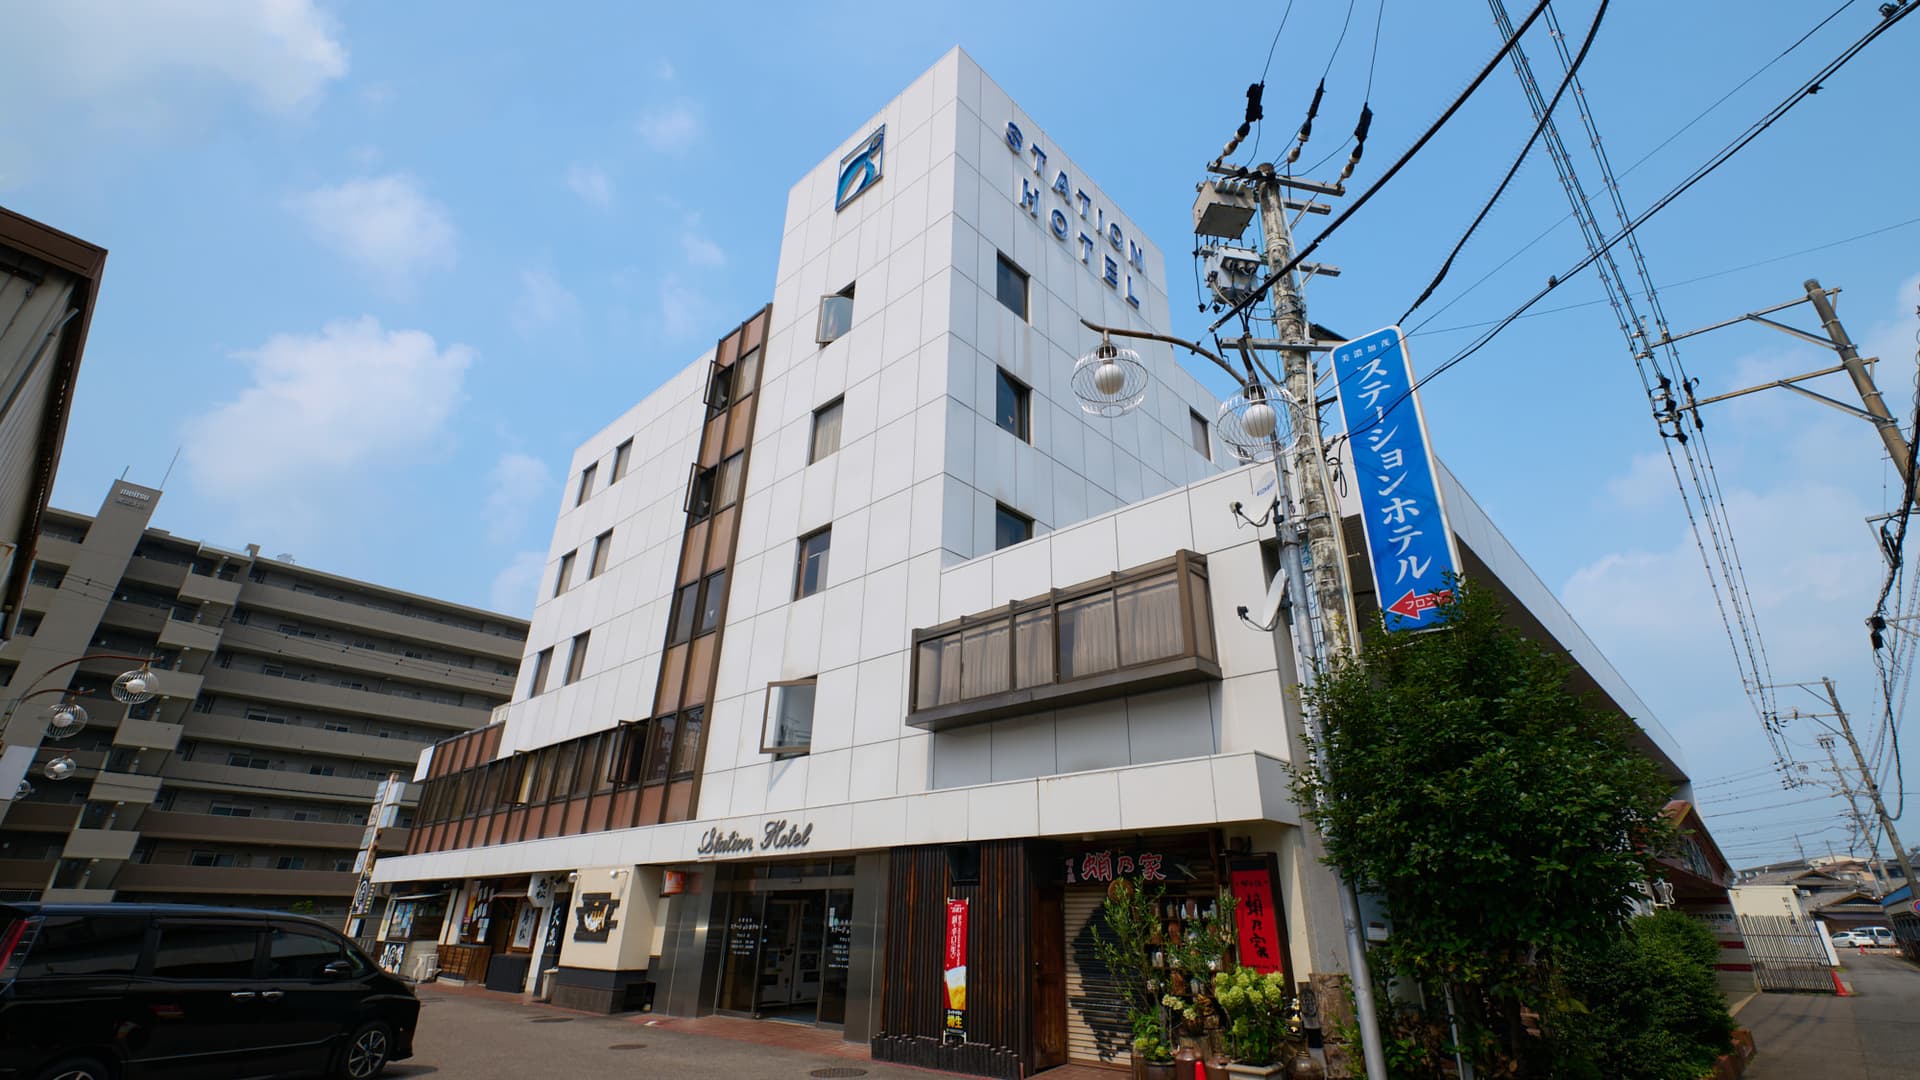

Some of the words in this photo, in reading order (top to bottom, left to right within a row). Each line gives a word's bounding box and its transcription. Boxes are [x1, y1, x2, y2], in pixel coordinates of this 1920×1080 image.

[1005, 122, 1143, 274] STATION
[1019, 177, 1140, 310] HOTEL
[1357, 357, 1432, 585] ステーションホテル
[697, 827, 753, 854] Station
[761, 819, 813, 850] Hotel
